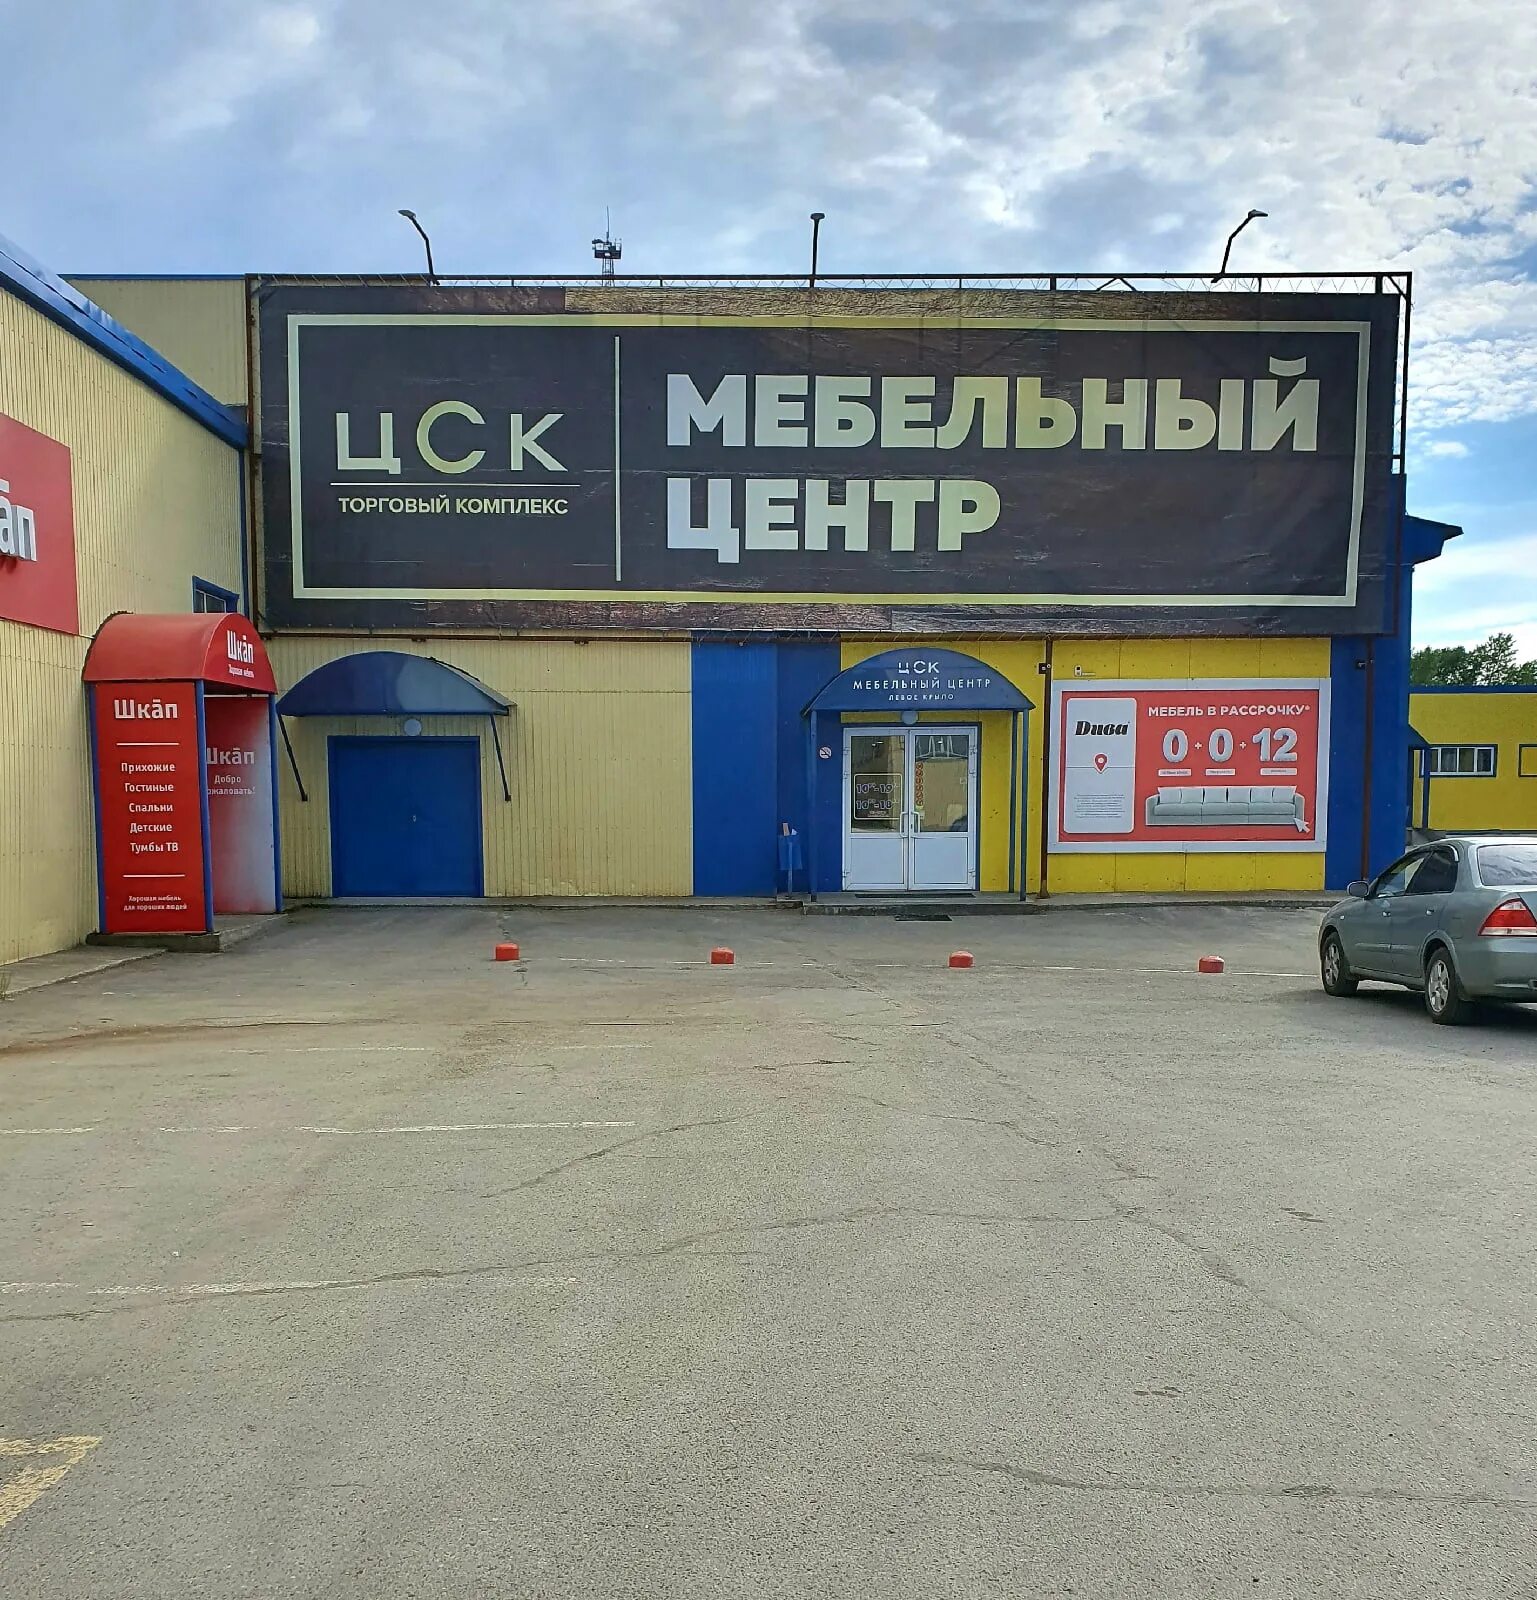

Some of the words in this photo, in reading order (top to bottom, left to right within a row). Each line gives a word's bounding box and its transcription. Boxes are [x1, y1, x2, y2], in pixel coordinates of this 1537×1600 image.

[667, 356, 1320, 452] МЕБЕЛЬНЫЙ
[336, 400, 568, 474] ЦСК
[338, 494, 451, 514] ТОРГОВЫЙ
[456, 497, 569, 515] КОМПЛЕКС
[667, 477, 1001, 564] ЦЕНТР
[898, 660, 940, 675] ЦСК
[853, 677, 940, 690] МЕБЕЛЬНЫЙ
[947, 679, 991, 690] ЦЕНТР
[1148, 706, 1204, 717] МЕБЕЛЬ
[1207, 705, 1217, 716] В
[1162, 728, 1189, 763] 0
[1208, 728, 1234, 763] 0
[1252, 727, 1298, 762] 12
[121, 762, 176, 774] Прихожие
[214, 774, 242, 785] Добро
[124, 782, 175, 793] Гостиные
[207, 786, 256, 795] ожаловать!
[129, 803, 174, 813] Спальни
[130, 822, 173, 834] Детские
[130, 841, 164, 854] Тумбы
[166, 842, 179, 852] ТВ
